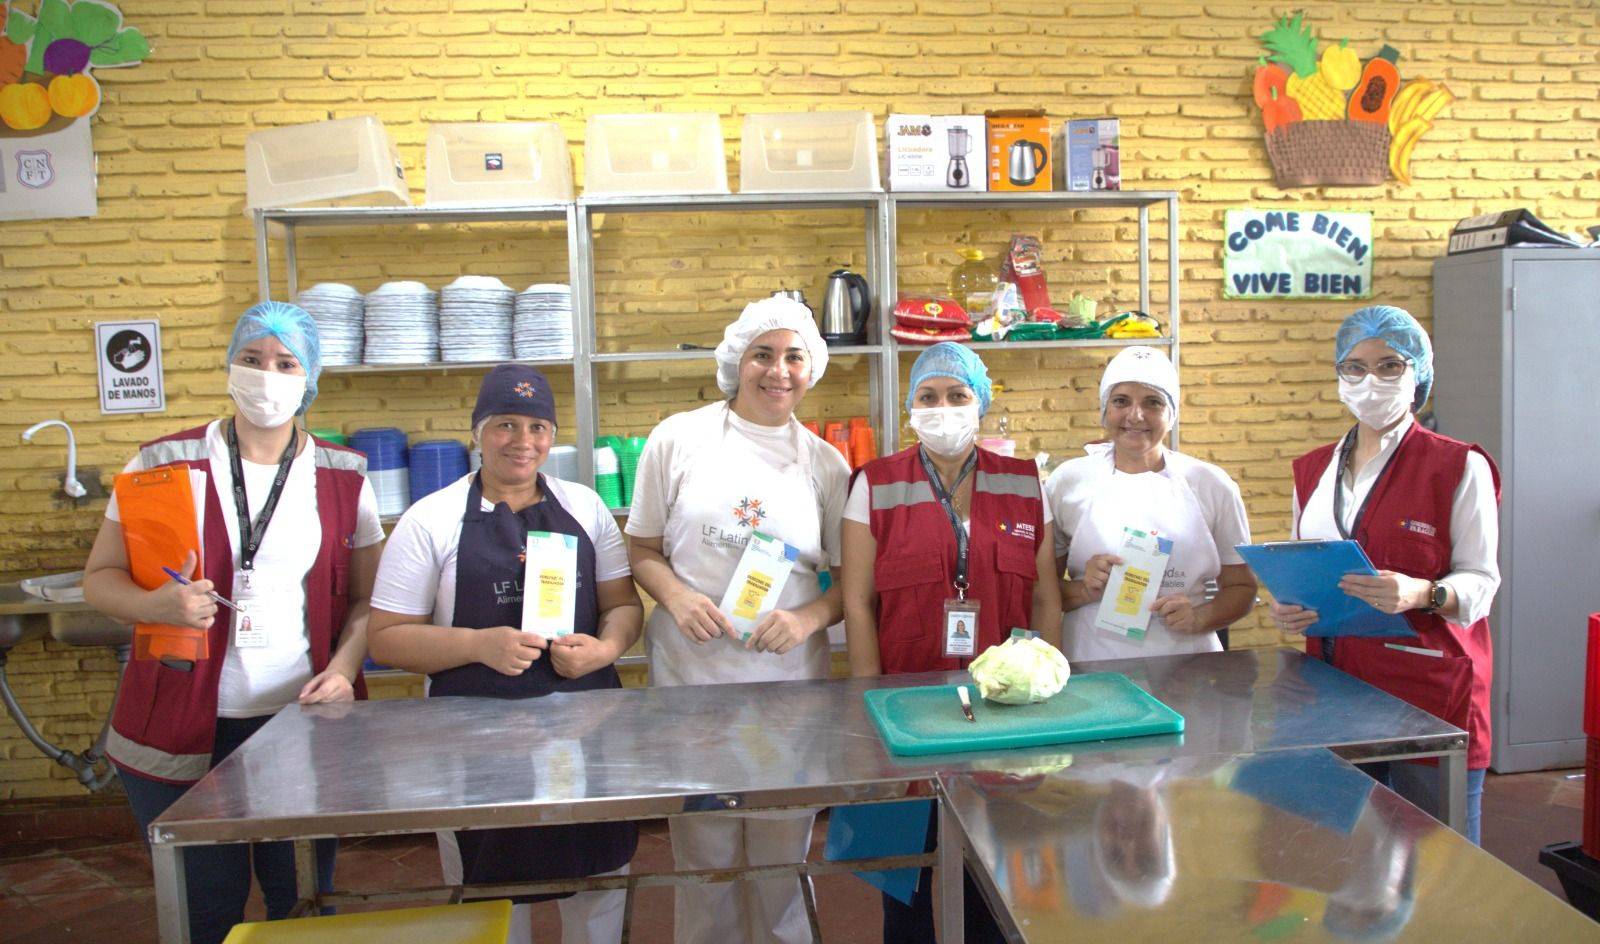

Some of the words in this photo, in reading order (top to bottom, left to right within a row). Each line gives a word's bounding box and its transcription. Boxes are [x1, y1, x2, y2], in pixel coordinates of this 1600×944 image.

[1228, 211, 1300, 252] COME
[1232, 272, 1292, 294] VIVE
[1303, 272, 1362, 295] BIEN
[112, 376, 150, 388] LAVADO
[107, 390, 121, 400] DE
[122, 388, 157, 400] MANOS
[702, 524, 717, 537] LF
[493, 581, 510, 594] LF
